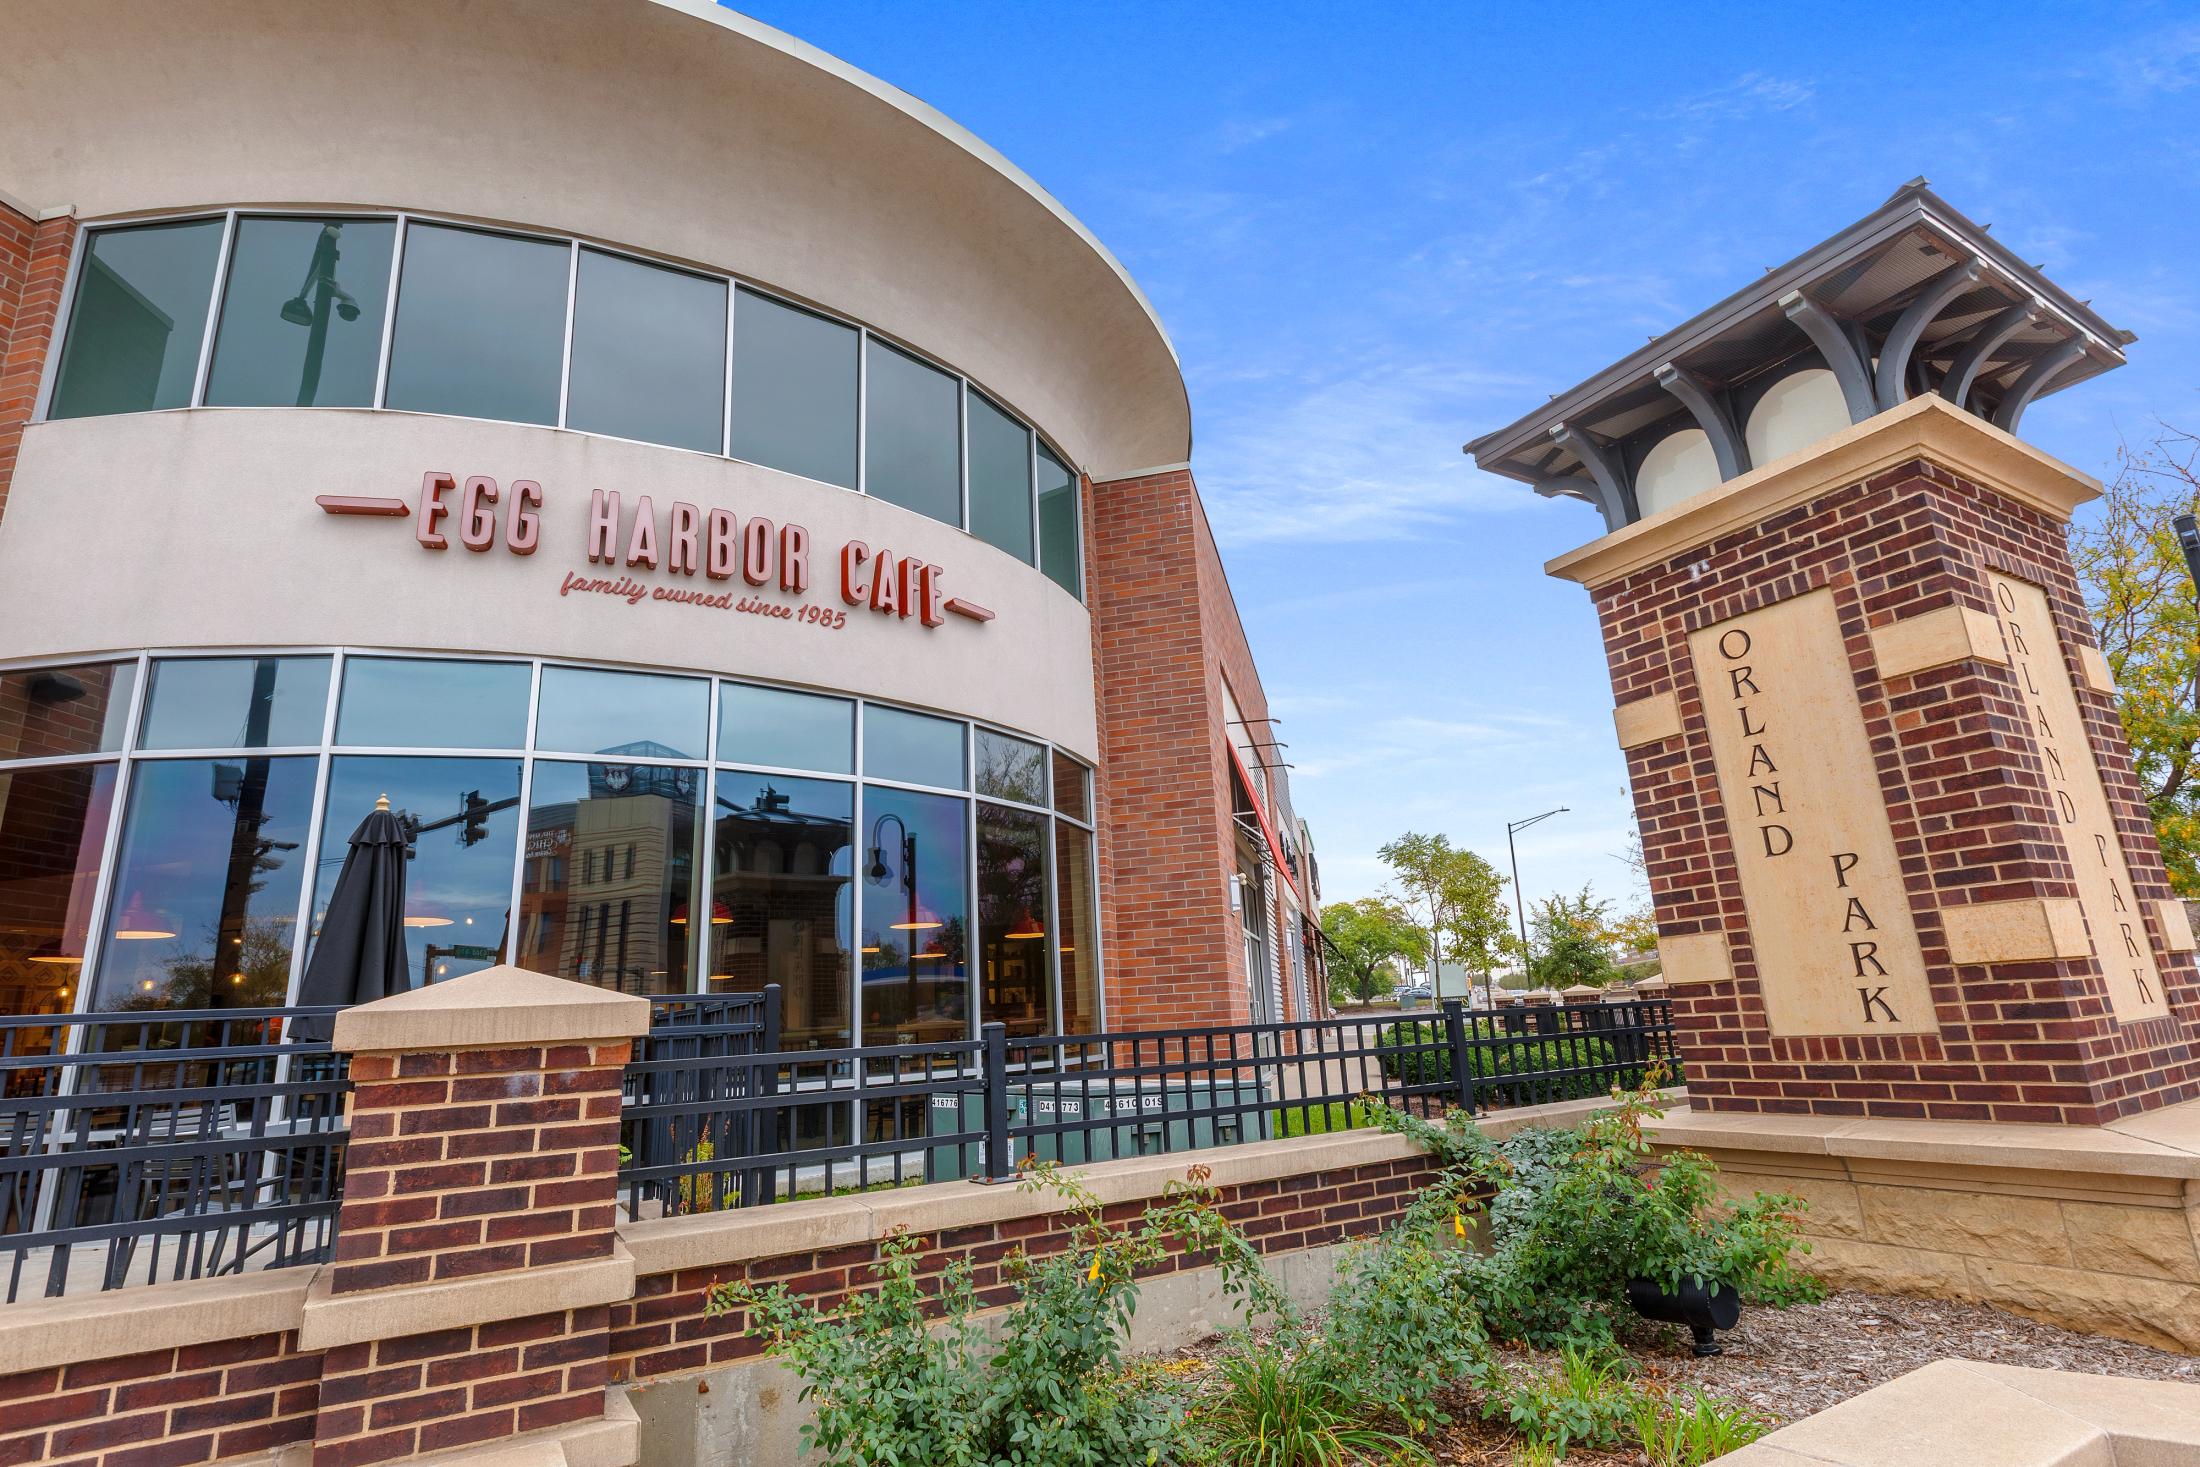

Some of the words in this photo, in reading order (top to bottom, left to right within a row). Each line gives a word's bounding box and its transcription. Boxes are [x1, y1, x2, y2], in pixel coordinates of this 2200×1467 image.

[416, 471, 543, 555] EGG
[588, 489, 810, 594] HARBOR
[841, 540, 945, 629] CAFE
[560, 570, 648, 604] family
[653, 585, 733, 611] owned
[736, 595, 794, 619] since
[798, 604, 848, 630] 1985
[1719, 629, 1793, 858] ORLAND
[1830, 852, 1900, 1023] PARK
[1997, 582, 2077, 824] ORLAND
[2094, 834, 2156, 1004] PARK
[1040, 1101, 1079, 1112] D41773
